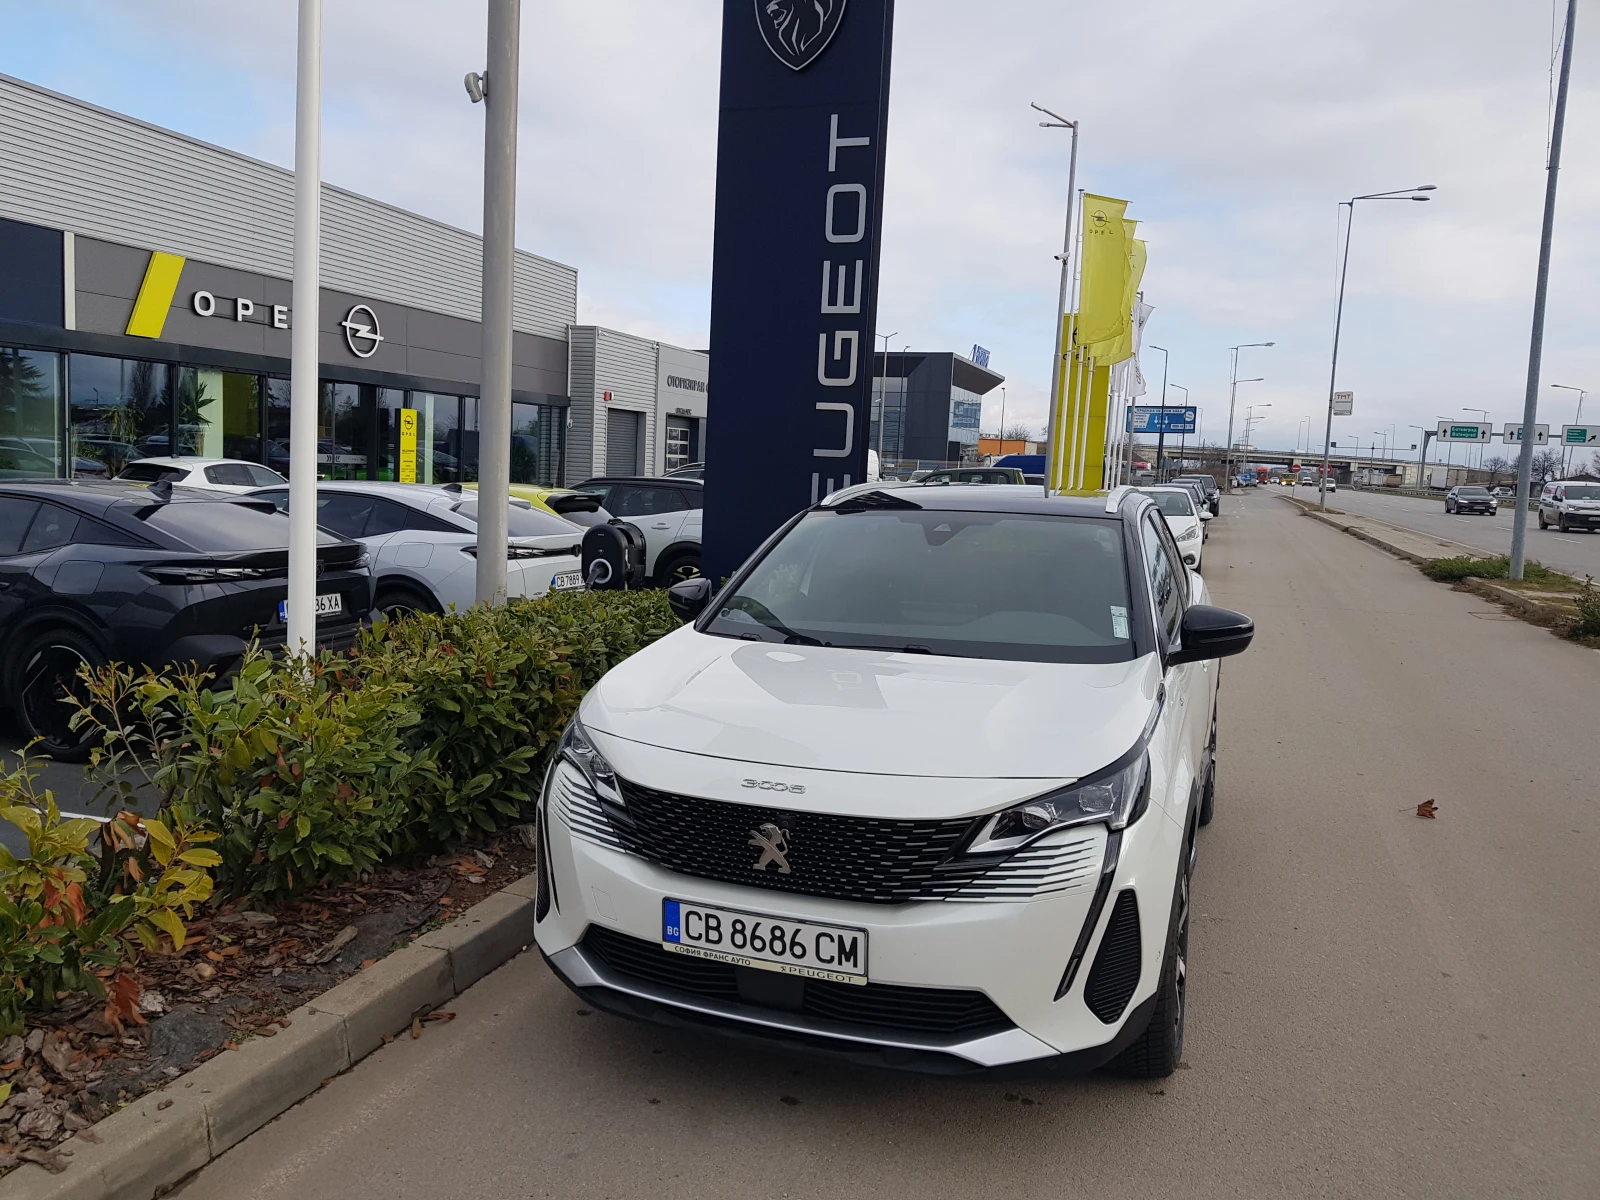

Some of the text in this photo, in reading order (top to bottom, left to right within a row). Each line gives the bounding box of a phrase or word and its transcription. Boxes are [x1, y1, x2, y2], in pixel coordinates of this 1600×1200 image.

[1088, 228, 1114, 236] OPEL
[192, 290, 288, 329] OPE
[811, 113, 870, 505] EUGEOT
[556, 575, 565, 588] CB
[565, 573, 580, 587] 7889
[315, 595, 340, 612] 36 XA
[741, 778, 807, 795] 3008
[667, 910, 859, 968] BG CB 8686 CM
[674, 945, 751, 966] СОФИЯ ФРАНС АУТО
[788, 966, 854, 983] PEUGEOT
